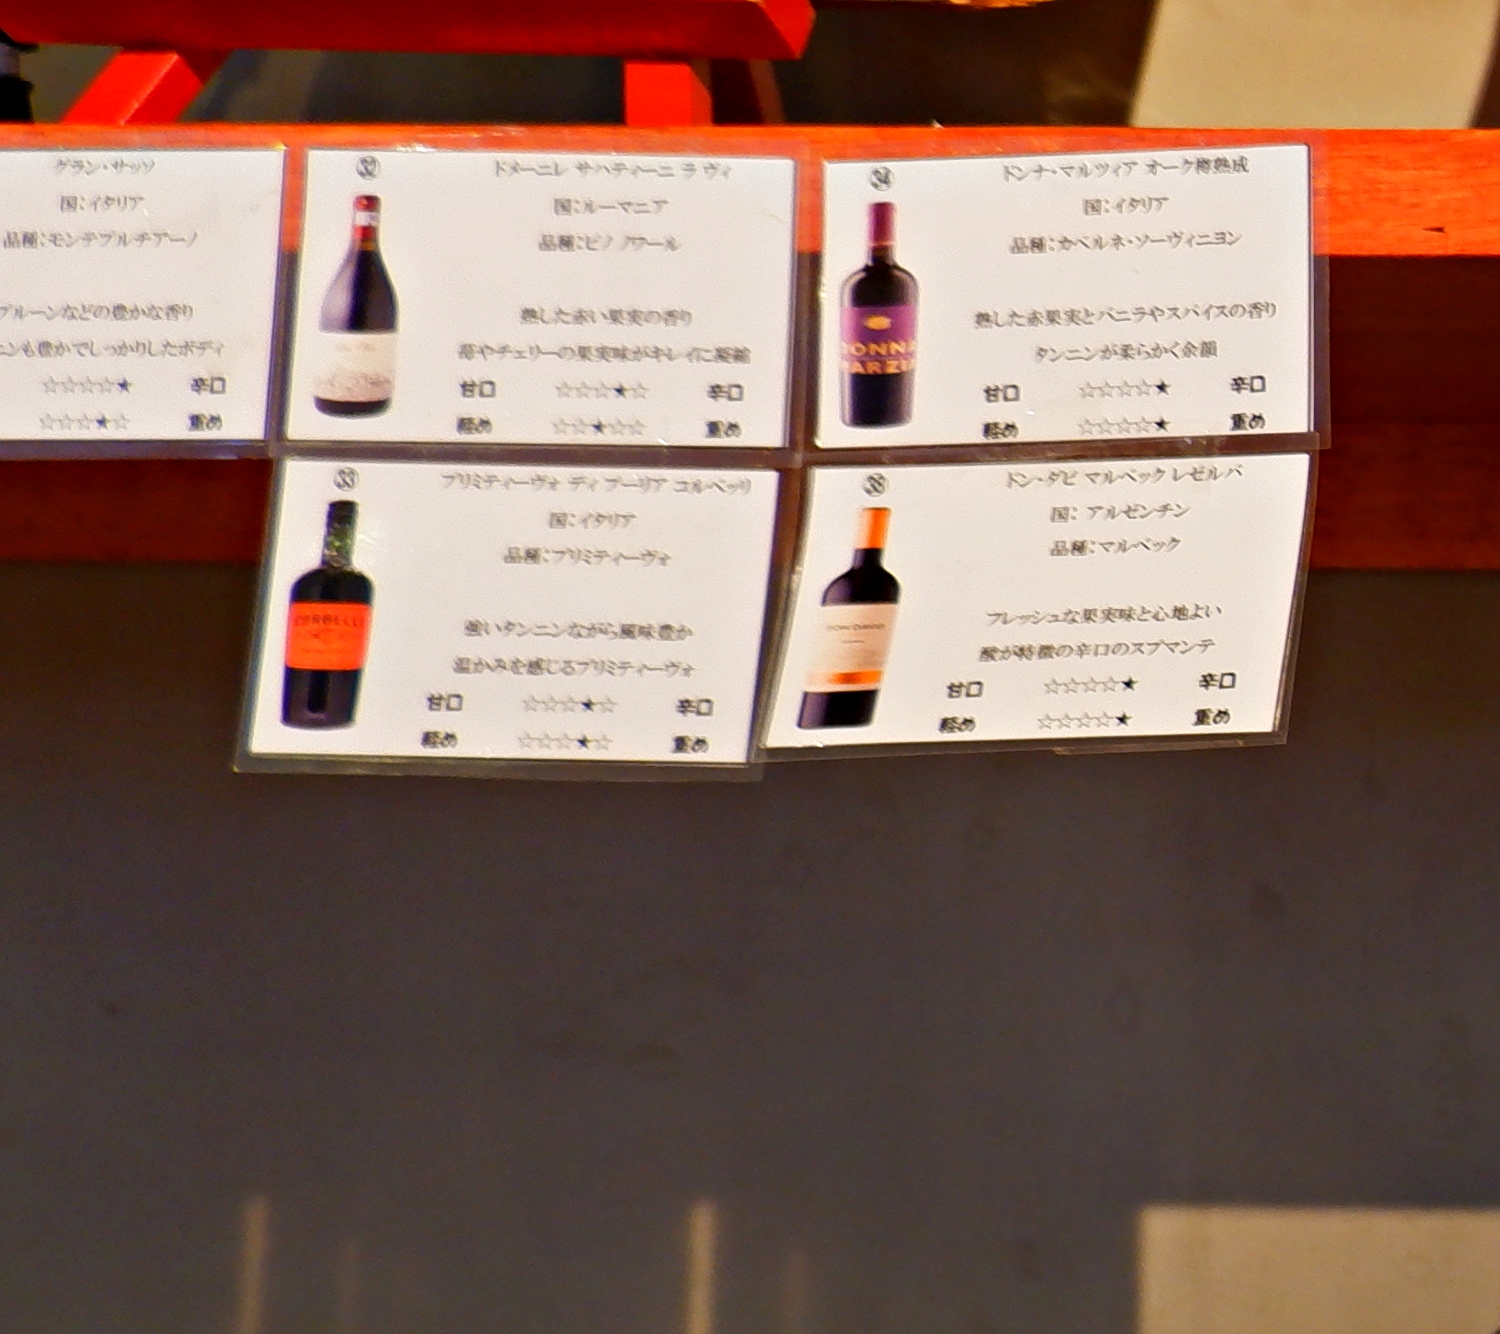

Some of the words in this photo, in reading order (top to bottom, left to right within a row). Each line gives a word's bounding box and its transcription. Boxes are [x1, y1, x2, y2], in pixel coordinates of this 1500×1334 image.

[60, 195, 144, 212] 国：イタリア
[1084, 196, 1169, 215] 国：イタリア
[984, 384, 1020, 402] 甘口
[1230, 375, 1266, 394] 辛口
[549, 511, 636, 529] 国：イタリア
[946, 681, 983, 699] 甘口
[1199, 672, 1236, 690] 辛口
